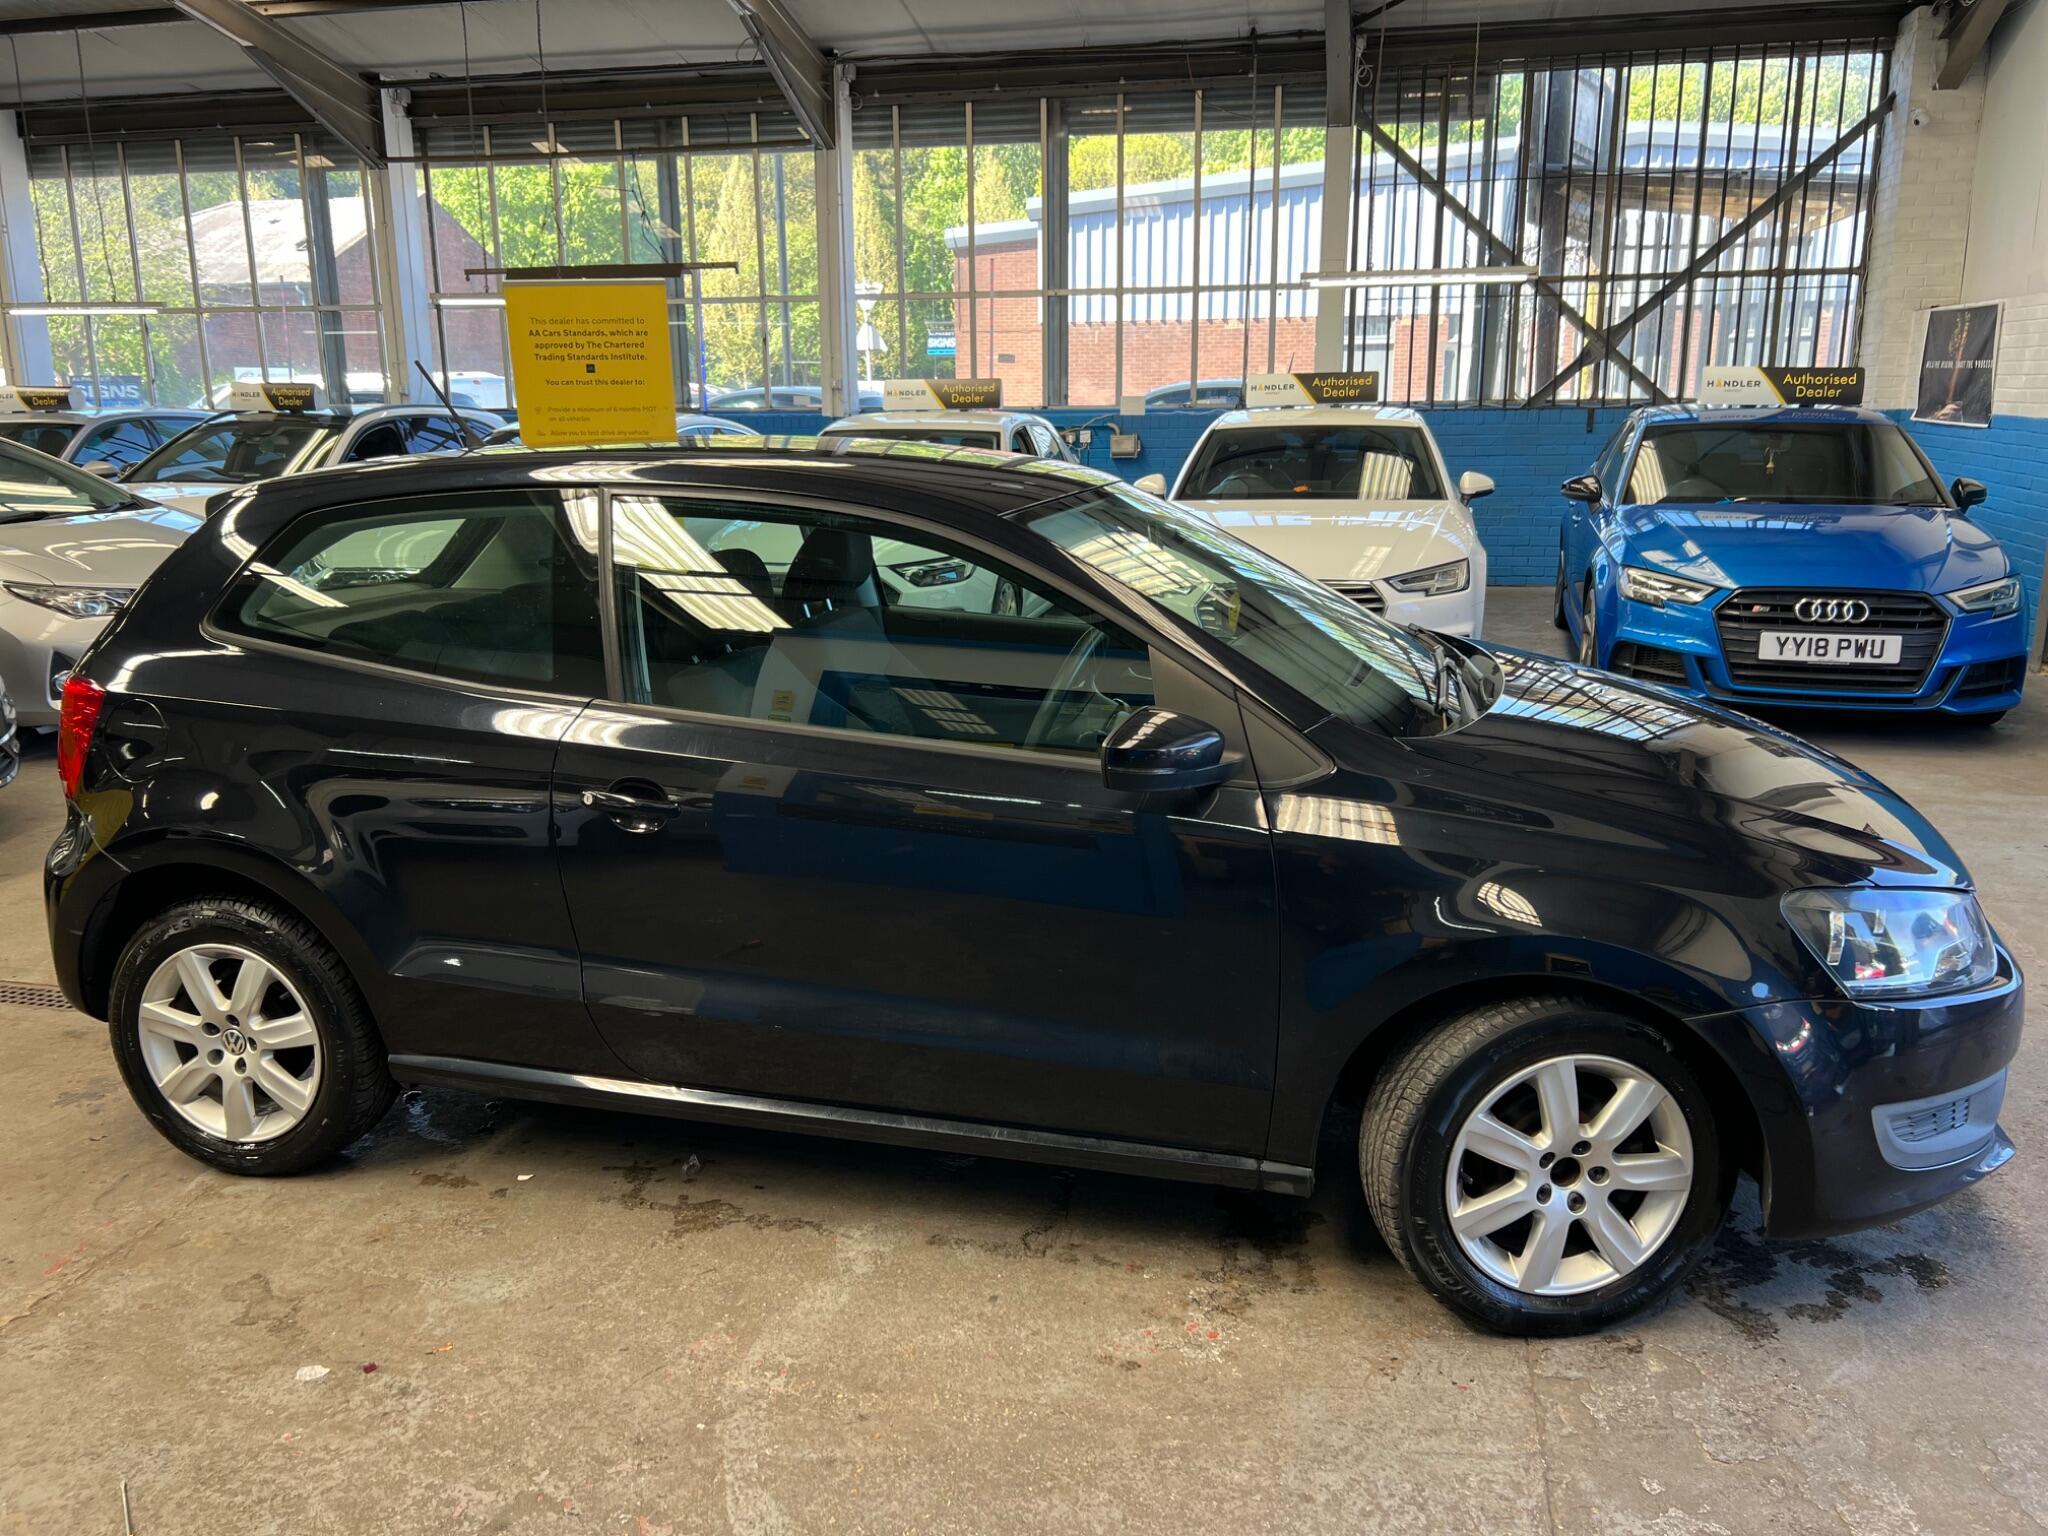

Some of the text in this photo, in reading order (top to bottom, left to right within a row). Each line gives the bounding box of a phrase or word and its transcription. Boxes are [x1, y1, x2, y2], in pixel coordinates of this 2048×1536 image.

[530, 317, 645, 325] This dealer has committed to
[528, 329, 648, 337] AA Cars Standards, which are
[534, 341, 573, 350] approved
[575, 341, 585, 350] by
[534, 353, 647, 362] Trading Standards Institute.
[1312, 376, 1373, 387] Authorised
[1783, 373, 1856, 385] Authorised
[271, 387, 311, 396] Authorised
[942, 384, 996, 393] Authorised
[1323, 387, 1360, 398] Dealer
[1795, 386, 1841, 398] Dealer
[32, 397, 58, 406] Dealer
[278, 397, 303, 406] Dealer
[951, 394, 984, 403] Dealer
[1776, 636, 1885, 659] YY18 PWU
